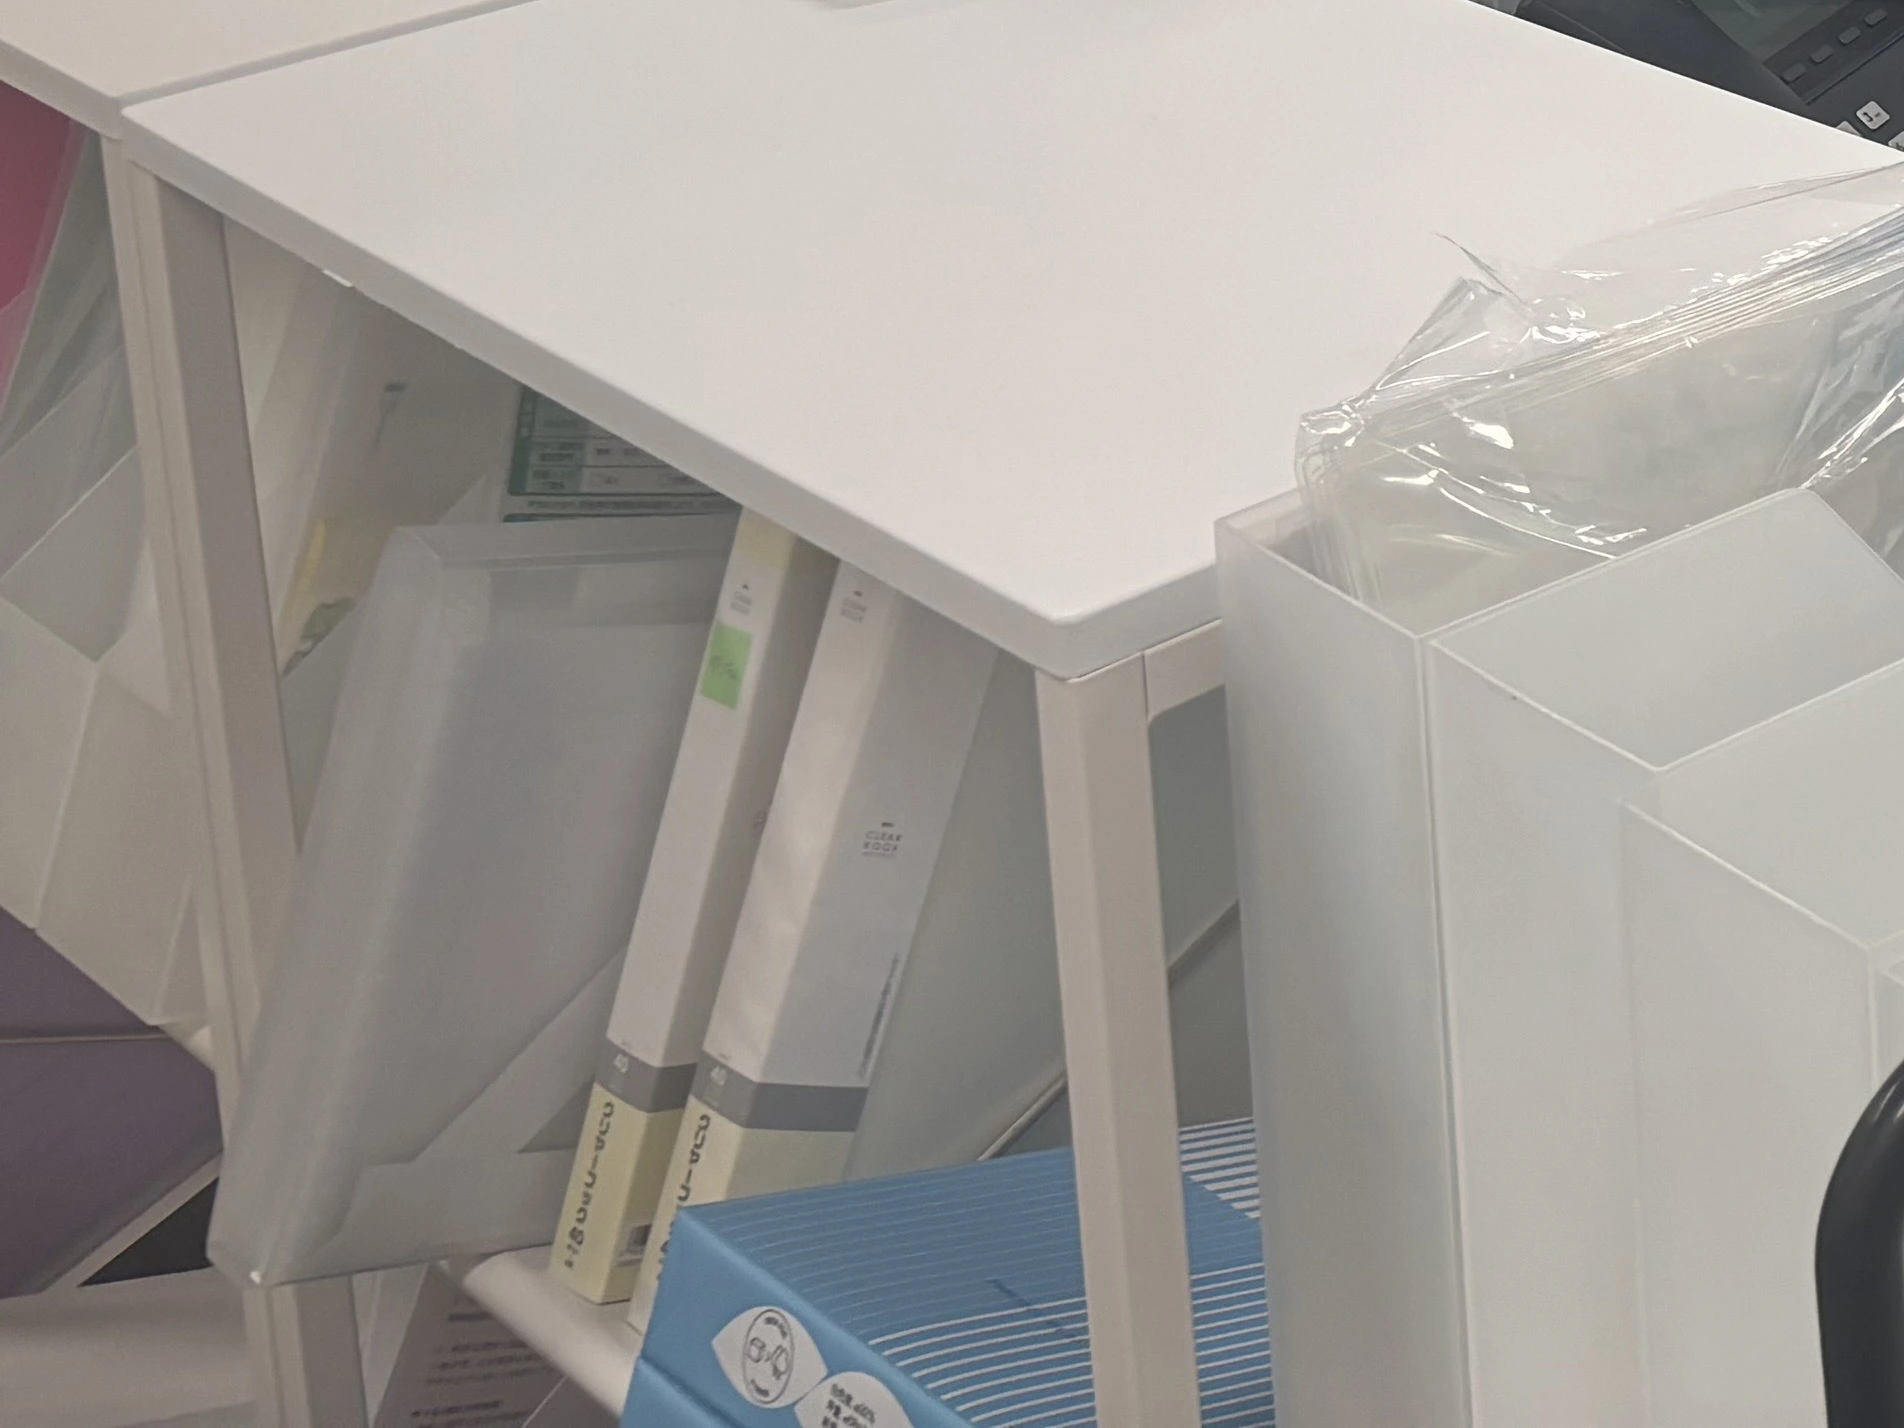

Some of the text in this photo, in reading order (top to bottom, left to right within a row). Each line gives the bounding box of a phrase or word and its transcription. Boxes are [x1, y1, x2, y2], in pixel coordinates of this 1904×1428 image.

[865, 830, 903, 842] CLEAR
[613, 1052, 629, 1074] 40
[710, 1066, 727, 1087] 40
